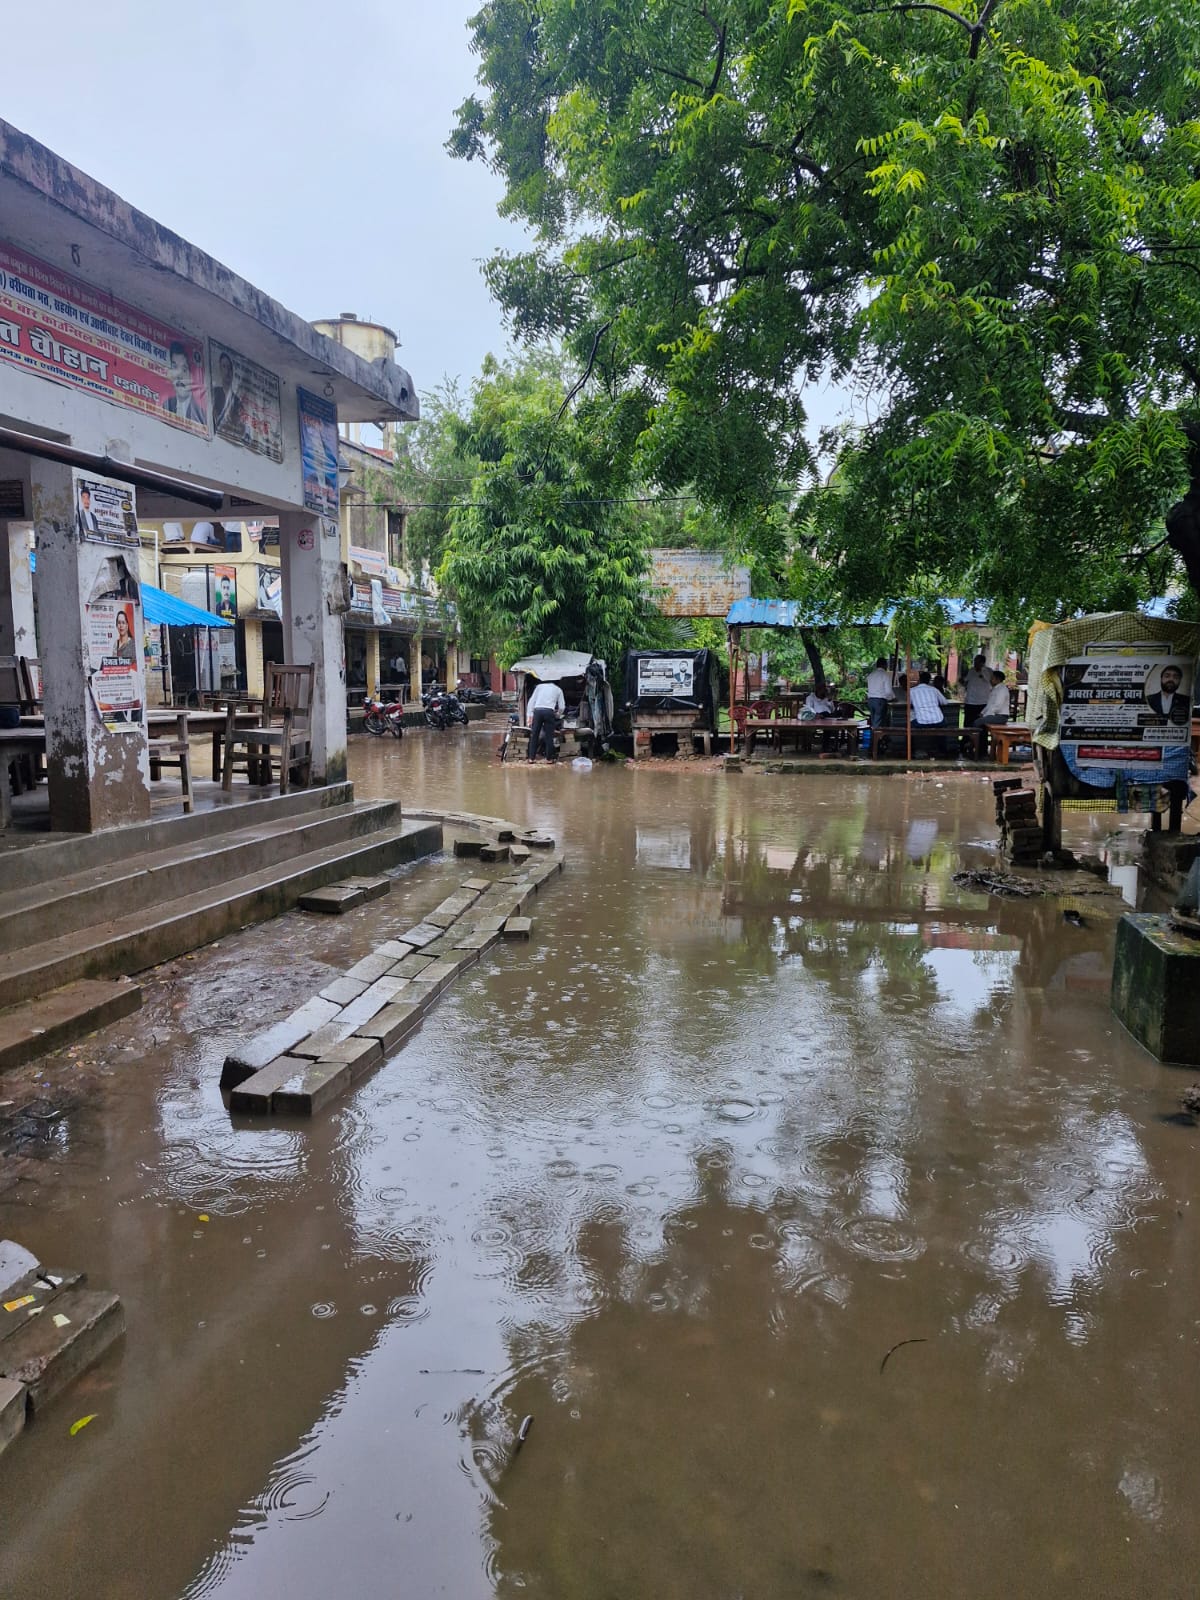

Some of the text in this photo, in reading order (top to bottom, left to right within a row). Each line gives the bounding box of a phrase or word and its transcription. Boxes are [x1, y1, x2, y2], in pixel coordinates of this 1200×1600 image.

[54, 298, 77, 320] सहयोग
[80, 310, 90, 326] एवं
[28, 327, 109, 381] चौहान
[1068, 689, 1143, 699] अबरार अहमद खान
